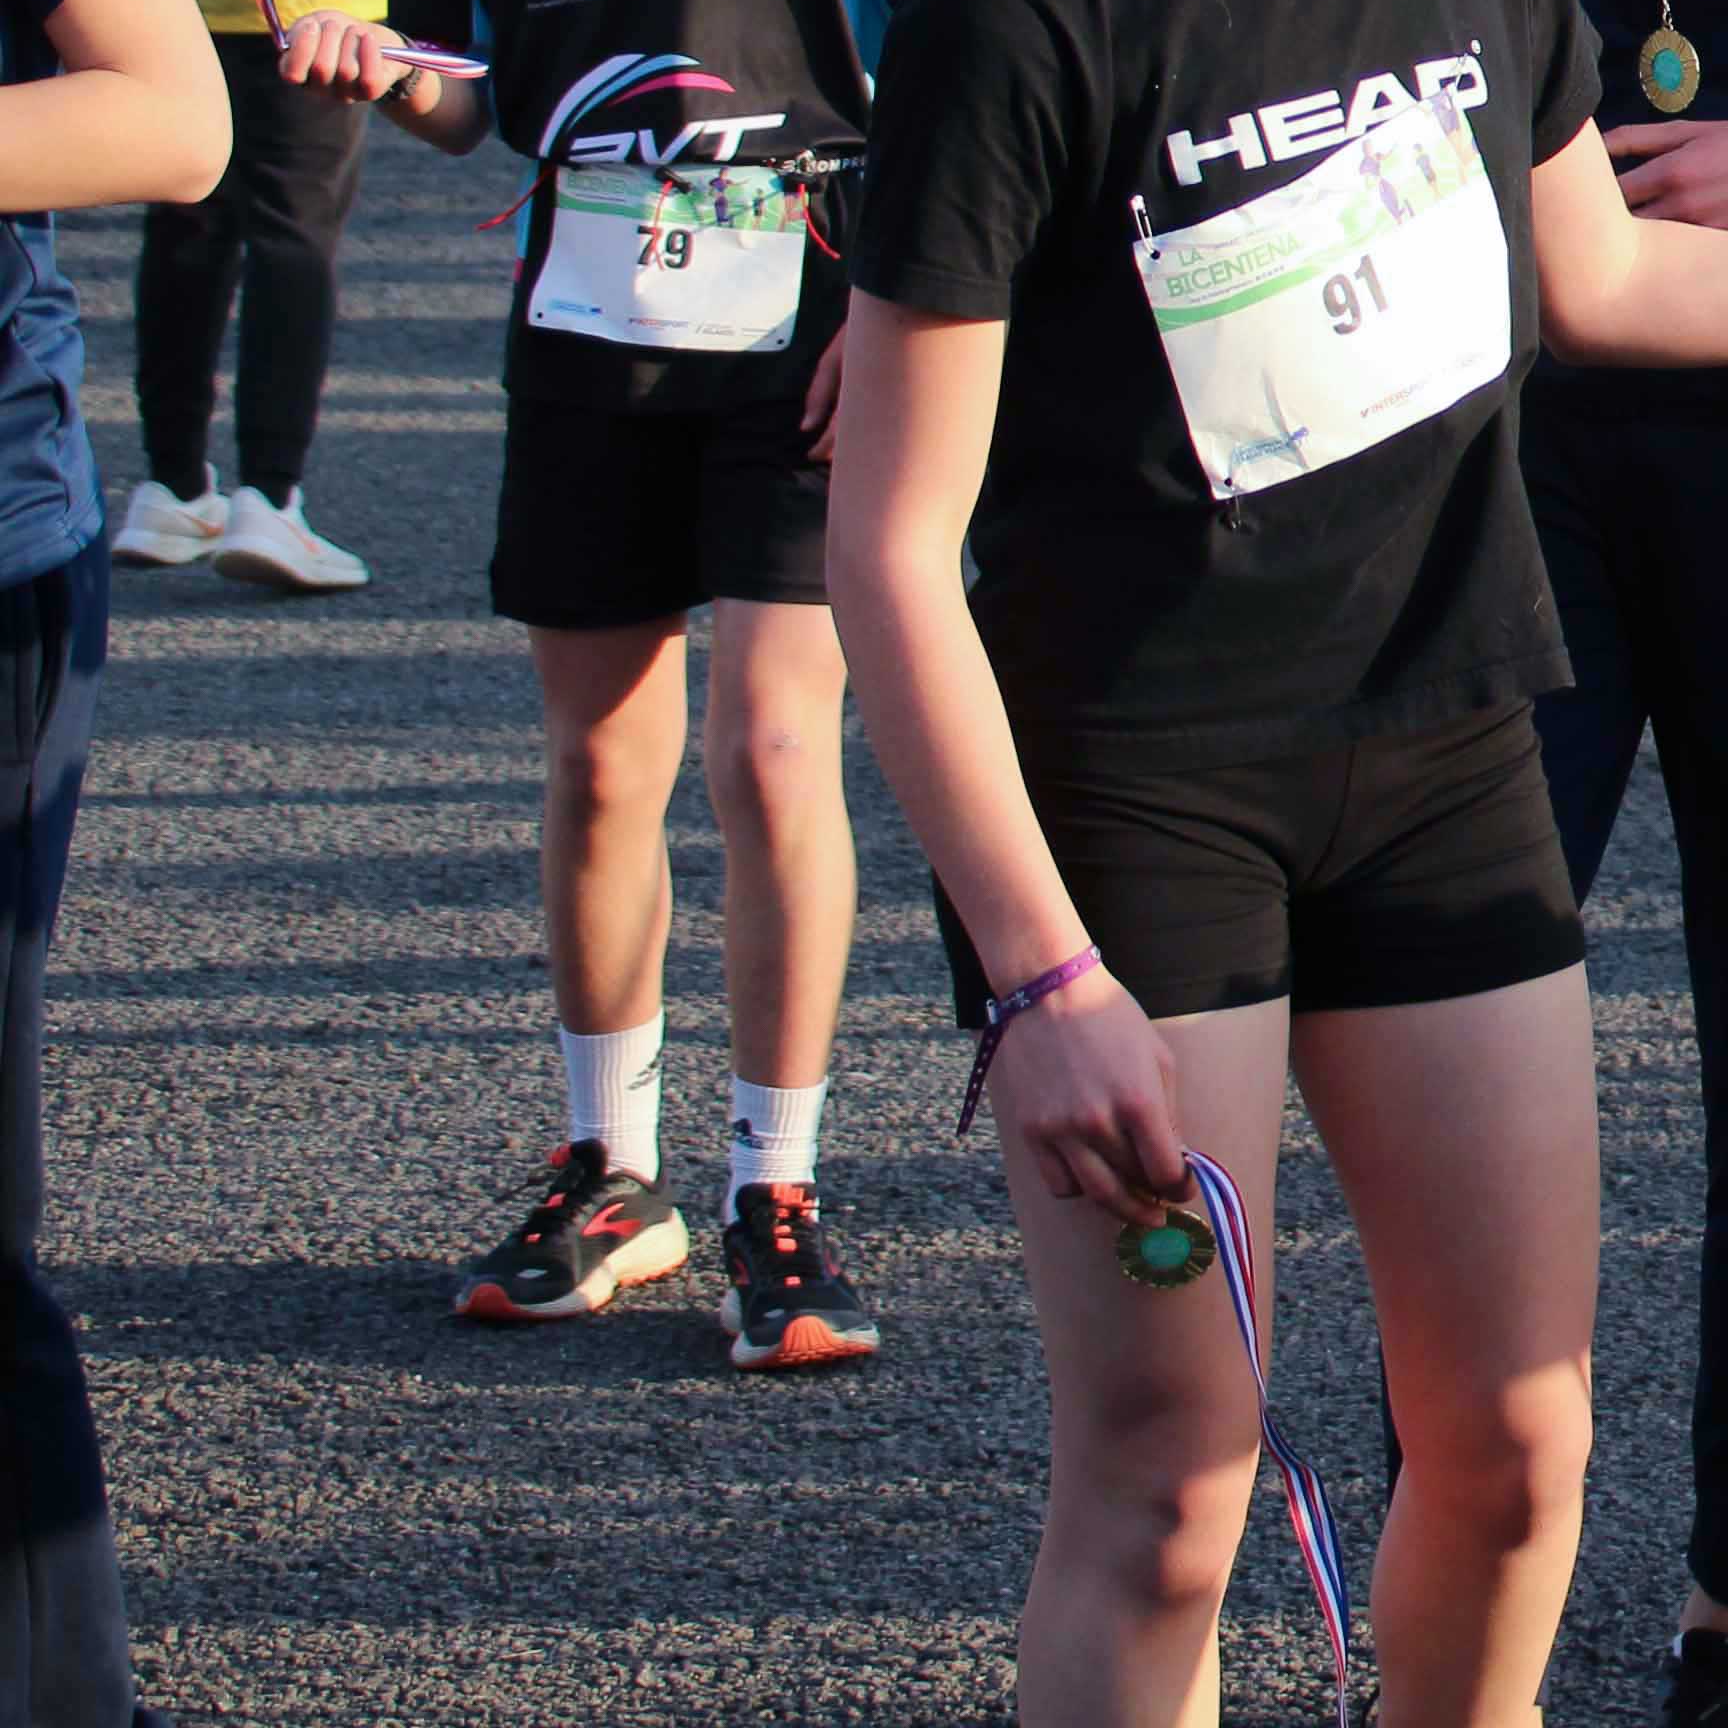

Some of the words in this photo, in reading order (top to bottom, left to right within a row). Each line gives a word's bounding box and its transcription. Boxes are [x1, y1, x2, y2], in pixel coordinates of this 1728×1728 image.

[1166, 54, 1488, 186] HEAD
[636, 225, 692, 270] 79
[1178, 248, 1203, 266] LA
[1322, 253, 1389, 336] 91
